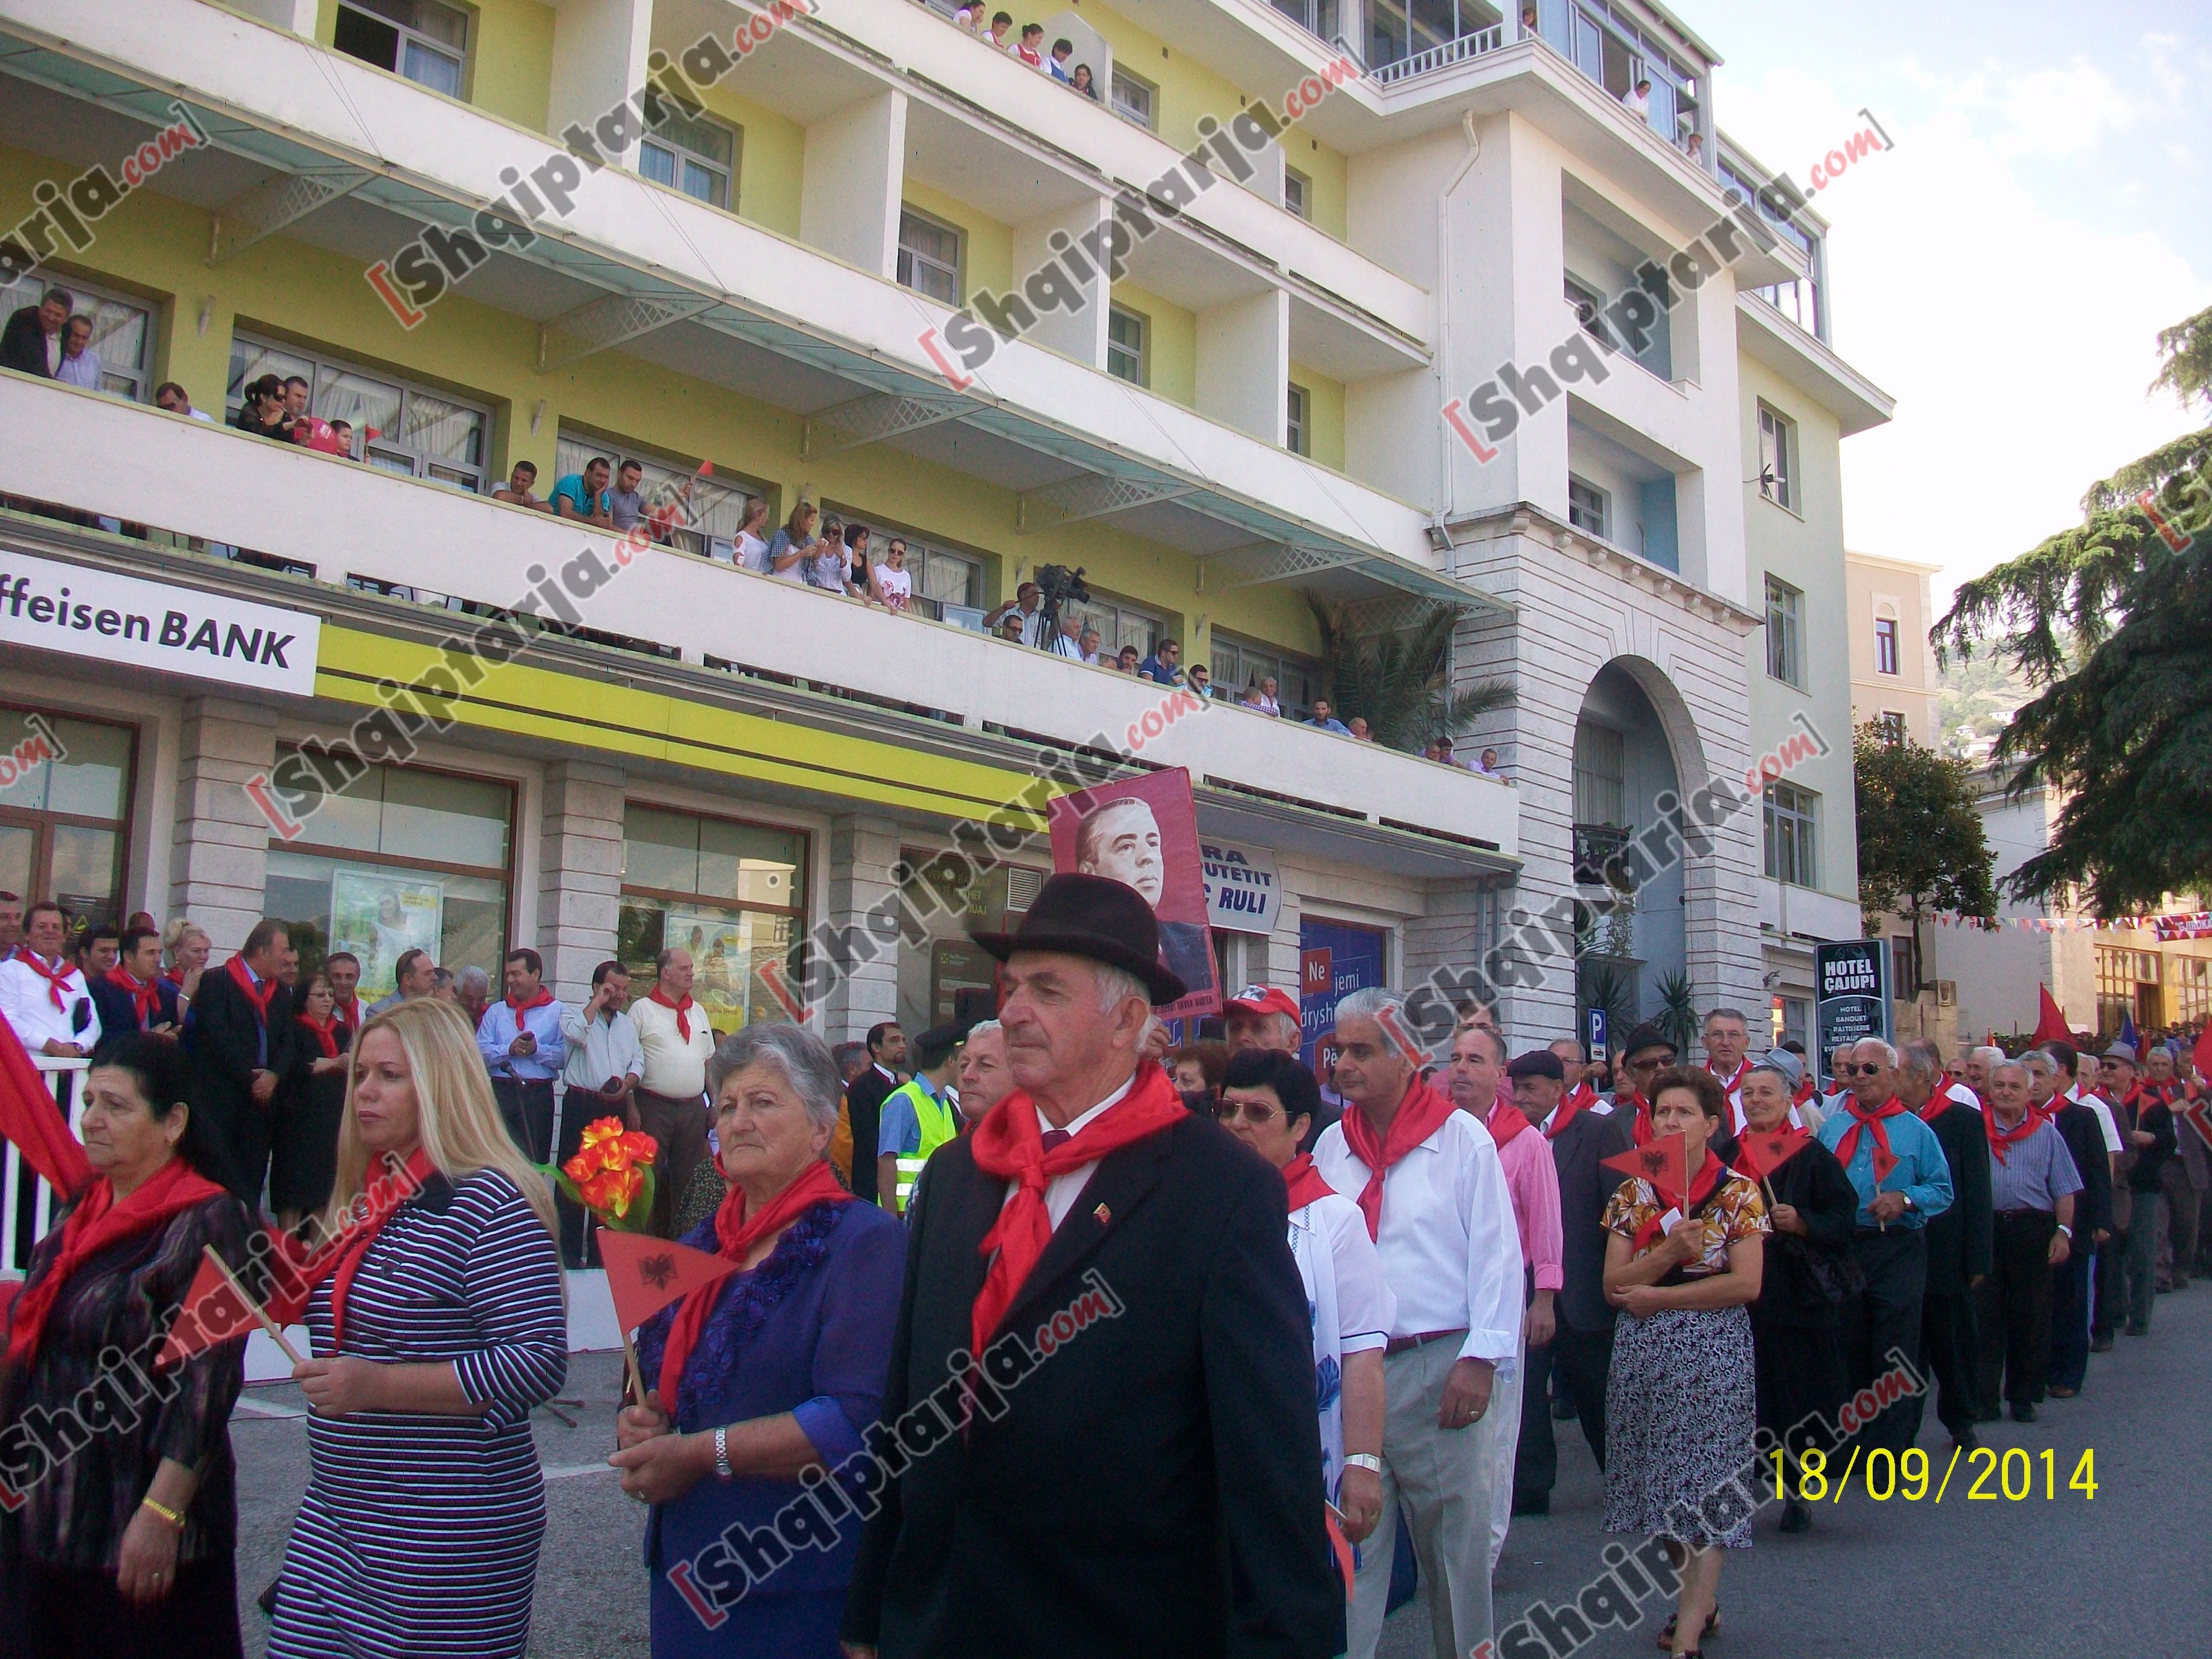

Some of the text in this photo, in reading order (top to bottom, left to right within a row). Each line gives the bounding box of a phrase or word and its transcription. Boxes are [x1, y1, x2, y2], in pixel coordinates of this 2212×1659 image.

[158, 610, 295, 669] BANK
[1200, 862, 1272, 886] UTETIT
[1219, 887, 1267, 914] RULI
[1309, 961, 1325, 982] Ne
[1825, 959, 1873, 976] HOTEL
[1335, 968, 1359, 997] jemi
[1824, 975, 1875, 993] ÇAJUPI
[1593, 1013, 1602, 1040] P
